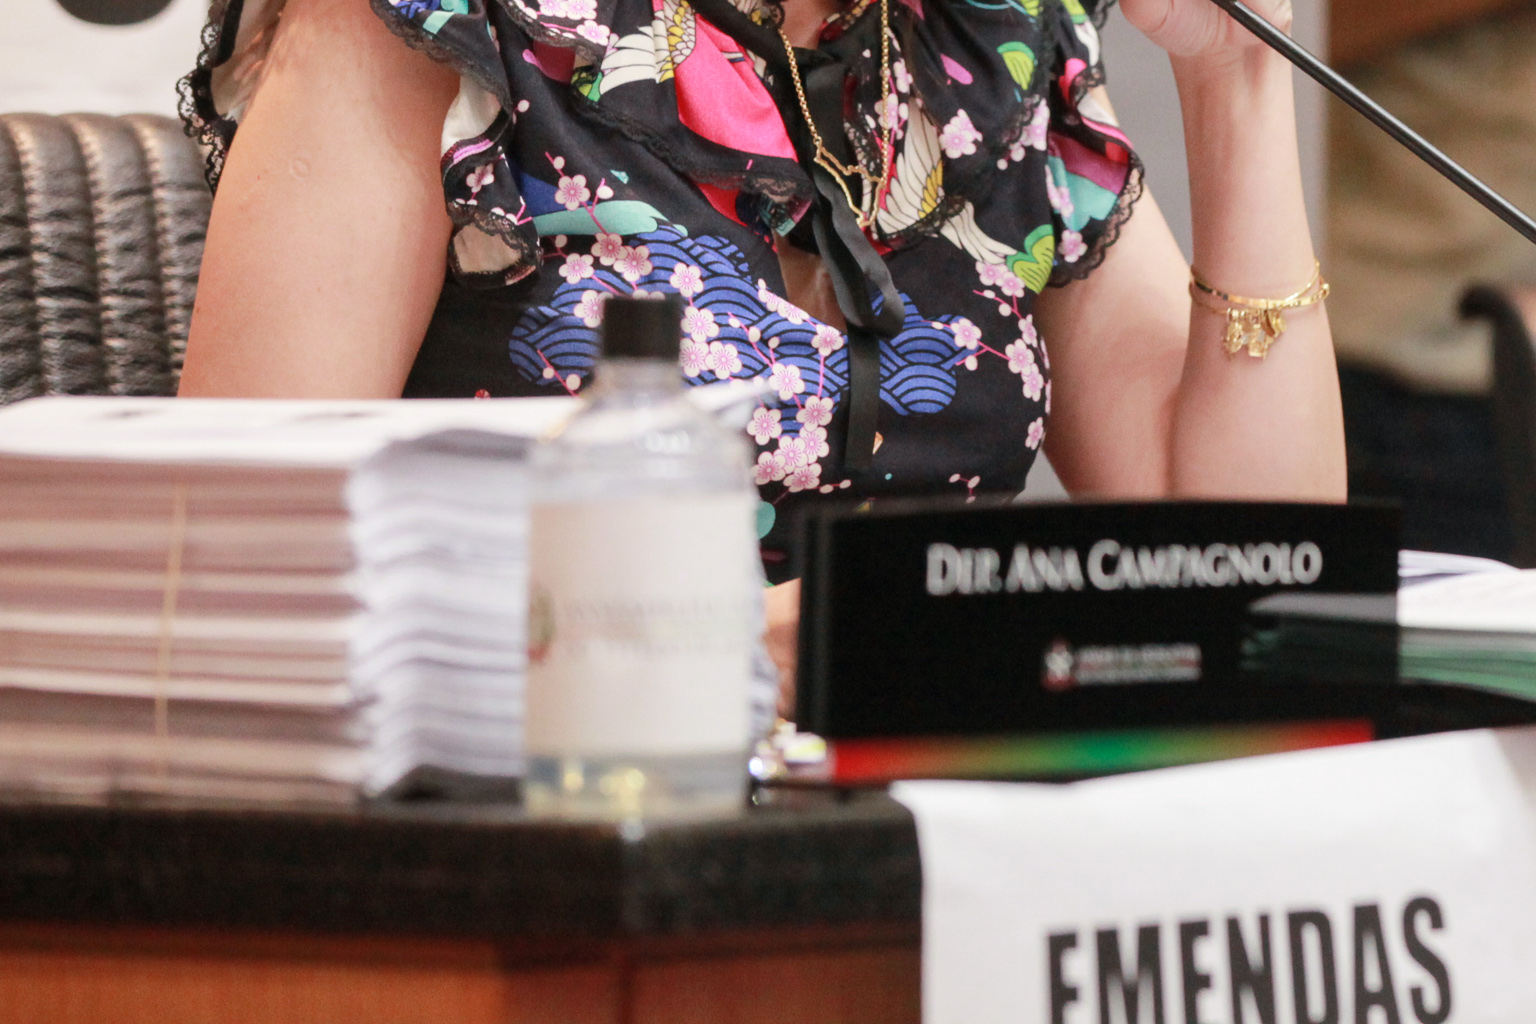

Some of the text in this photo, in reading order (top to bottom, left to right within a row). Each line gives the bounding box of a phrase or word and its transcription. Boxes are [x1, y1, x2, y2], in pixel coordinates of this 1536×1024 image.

[1005, 543, 1084, 593] ANA
[1087, 539, 1323, 591] CAMPAGNOLO
[1047, 896, 1453, 1024] EMENDAS
